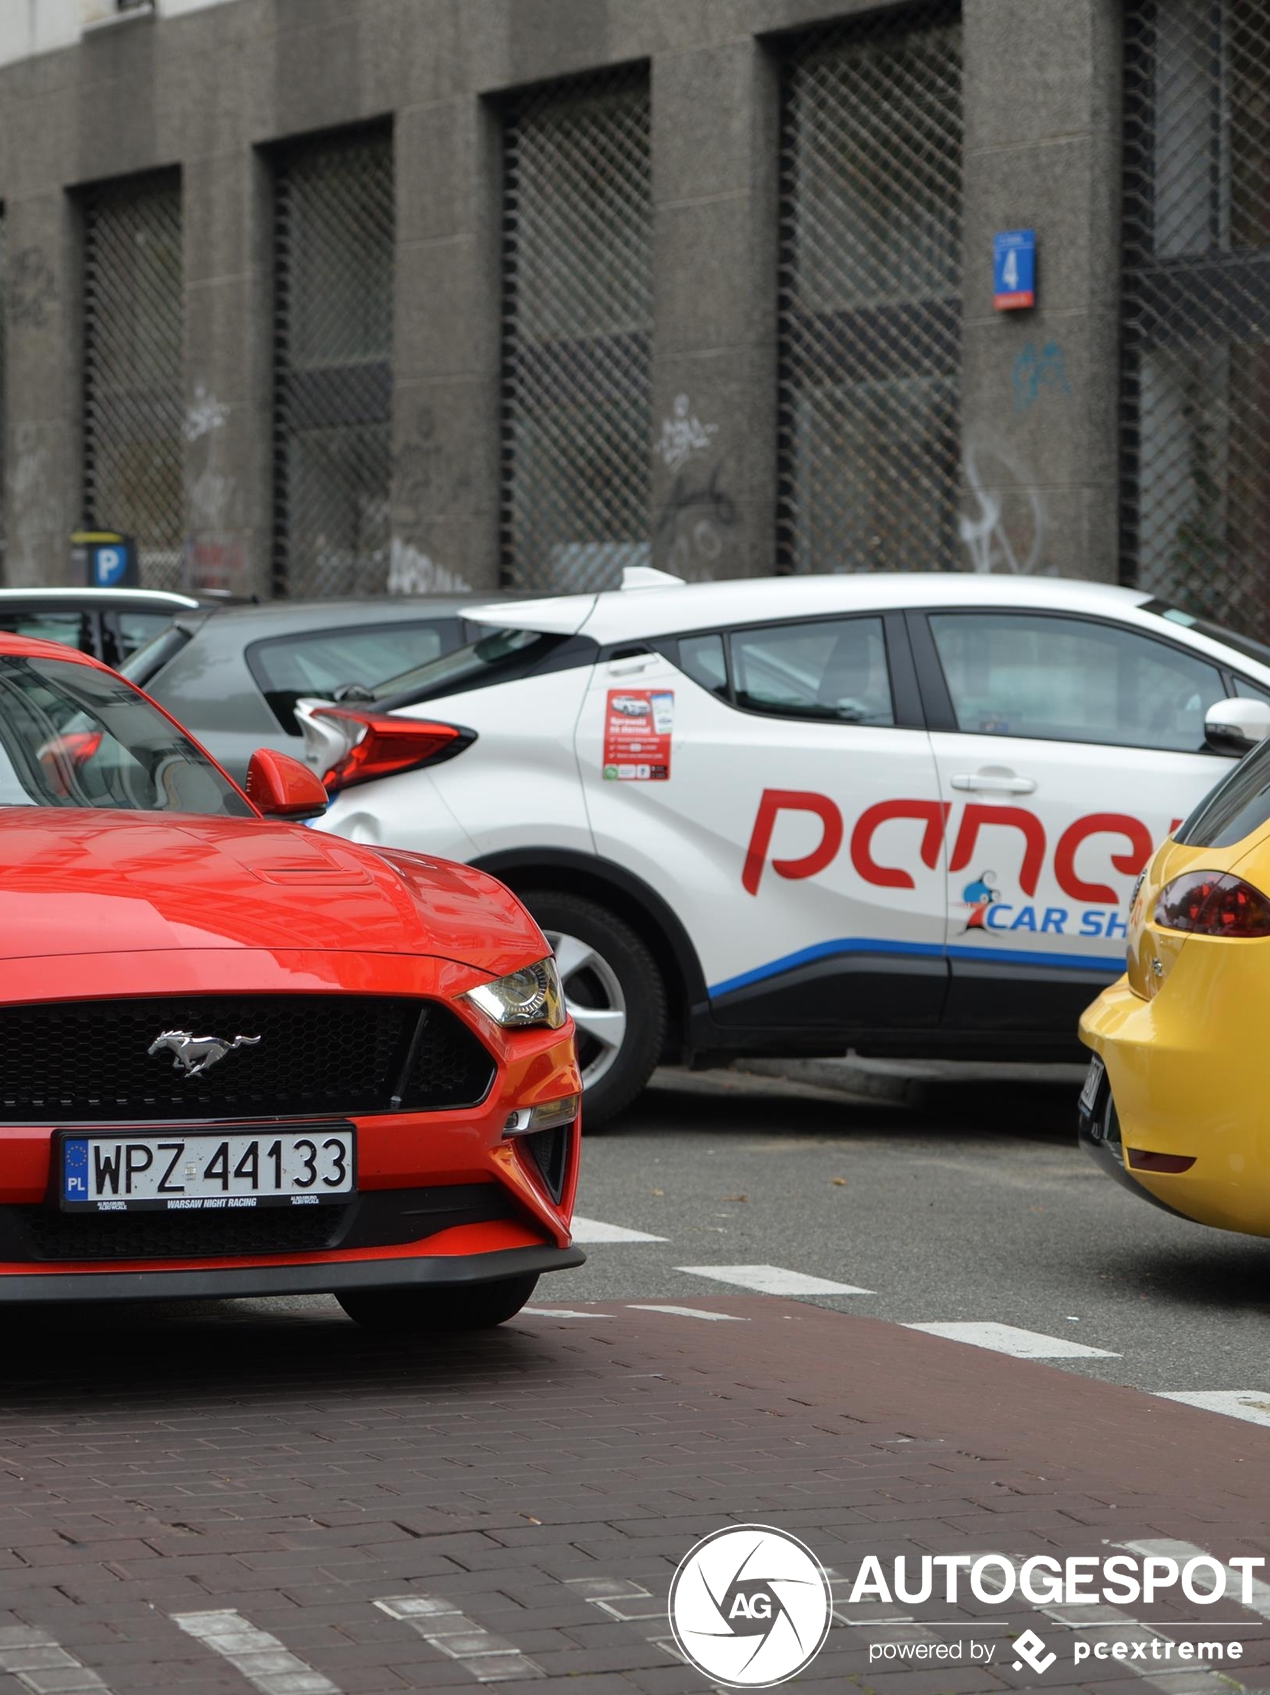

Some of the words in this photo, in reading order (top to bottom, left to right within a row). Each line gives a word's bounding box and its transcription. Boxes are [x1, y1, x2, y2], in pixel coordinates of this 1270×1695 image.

[1002, 248, 1019, 291] 4
[97, 549, 119, 581] P
[742, 788, 1183, 904] pane
[986, 903, 1069, 934] CAR
[94, 1142, 186, 1195] WPZ
[203, 1138, 347, 1191] 44133
[67, 1177, 85, 1192] PL
[167, 1199, 203, 1209] WARSAW
[204, 1198, 228, 1208] NIGHT
[228, 1197, 257, 1207] RACING
